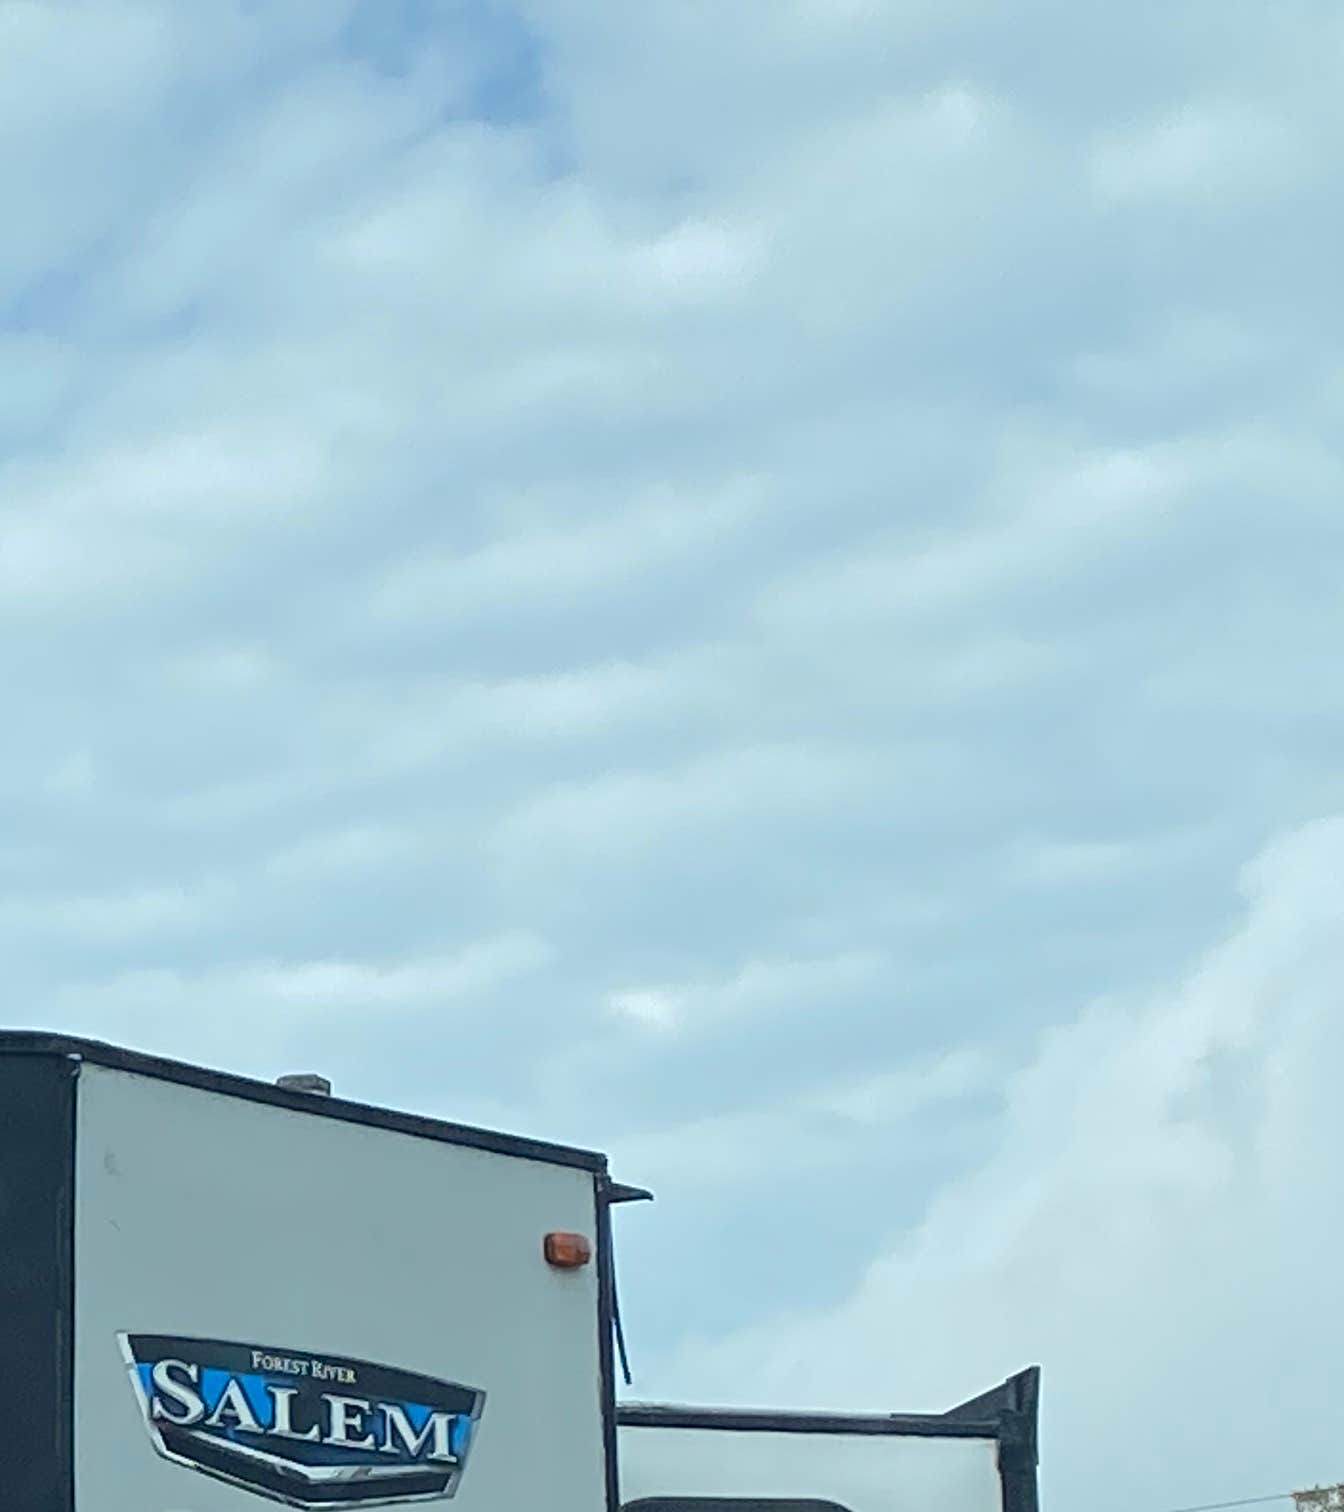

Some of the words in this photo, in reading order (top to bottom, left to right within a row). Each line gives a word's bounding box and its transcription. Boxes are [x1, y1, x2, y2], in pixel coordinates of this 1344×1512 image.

[252, 1351, 309, 1375] FOREST
[311, 1360, 357, 1384] RIVER
[152, 1360, 458, 1462] SALEM
